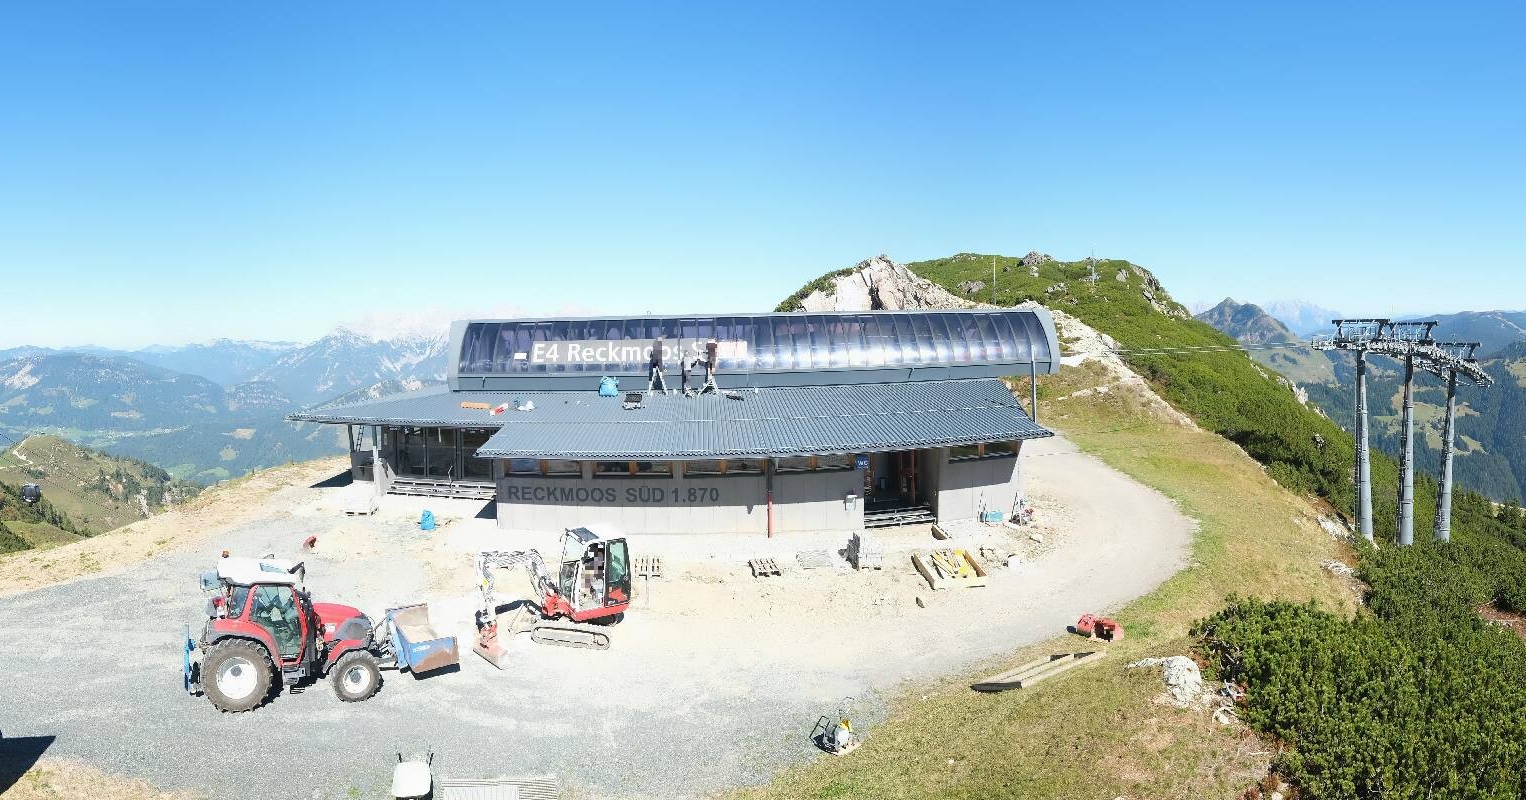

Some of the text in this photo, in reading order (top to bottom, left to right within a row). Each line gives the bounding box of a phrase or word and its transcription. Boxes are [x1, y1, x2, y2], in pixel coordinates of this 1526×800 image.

[533, 343, 559, 362] E4
[507, 485, 720, 502] RECKMOOS SÜD 1.870
